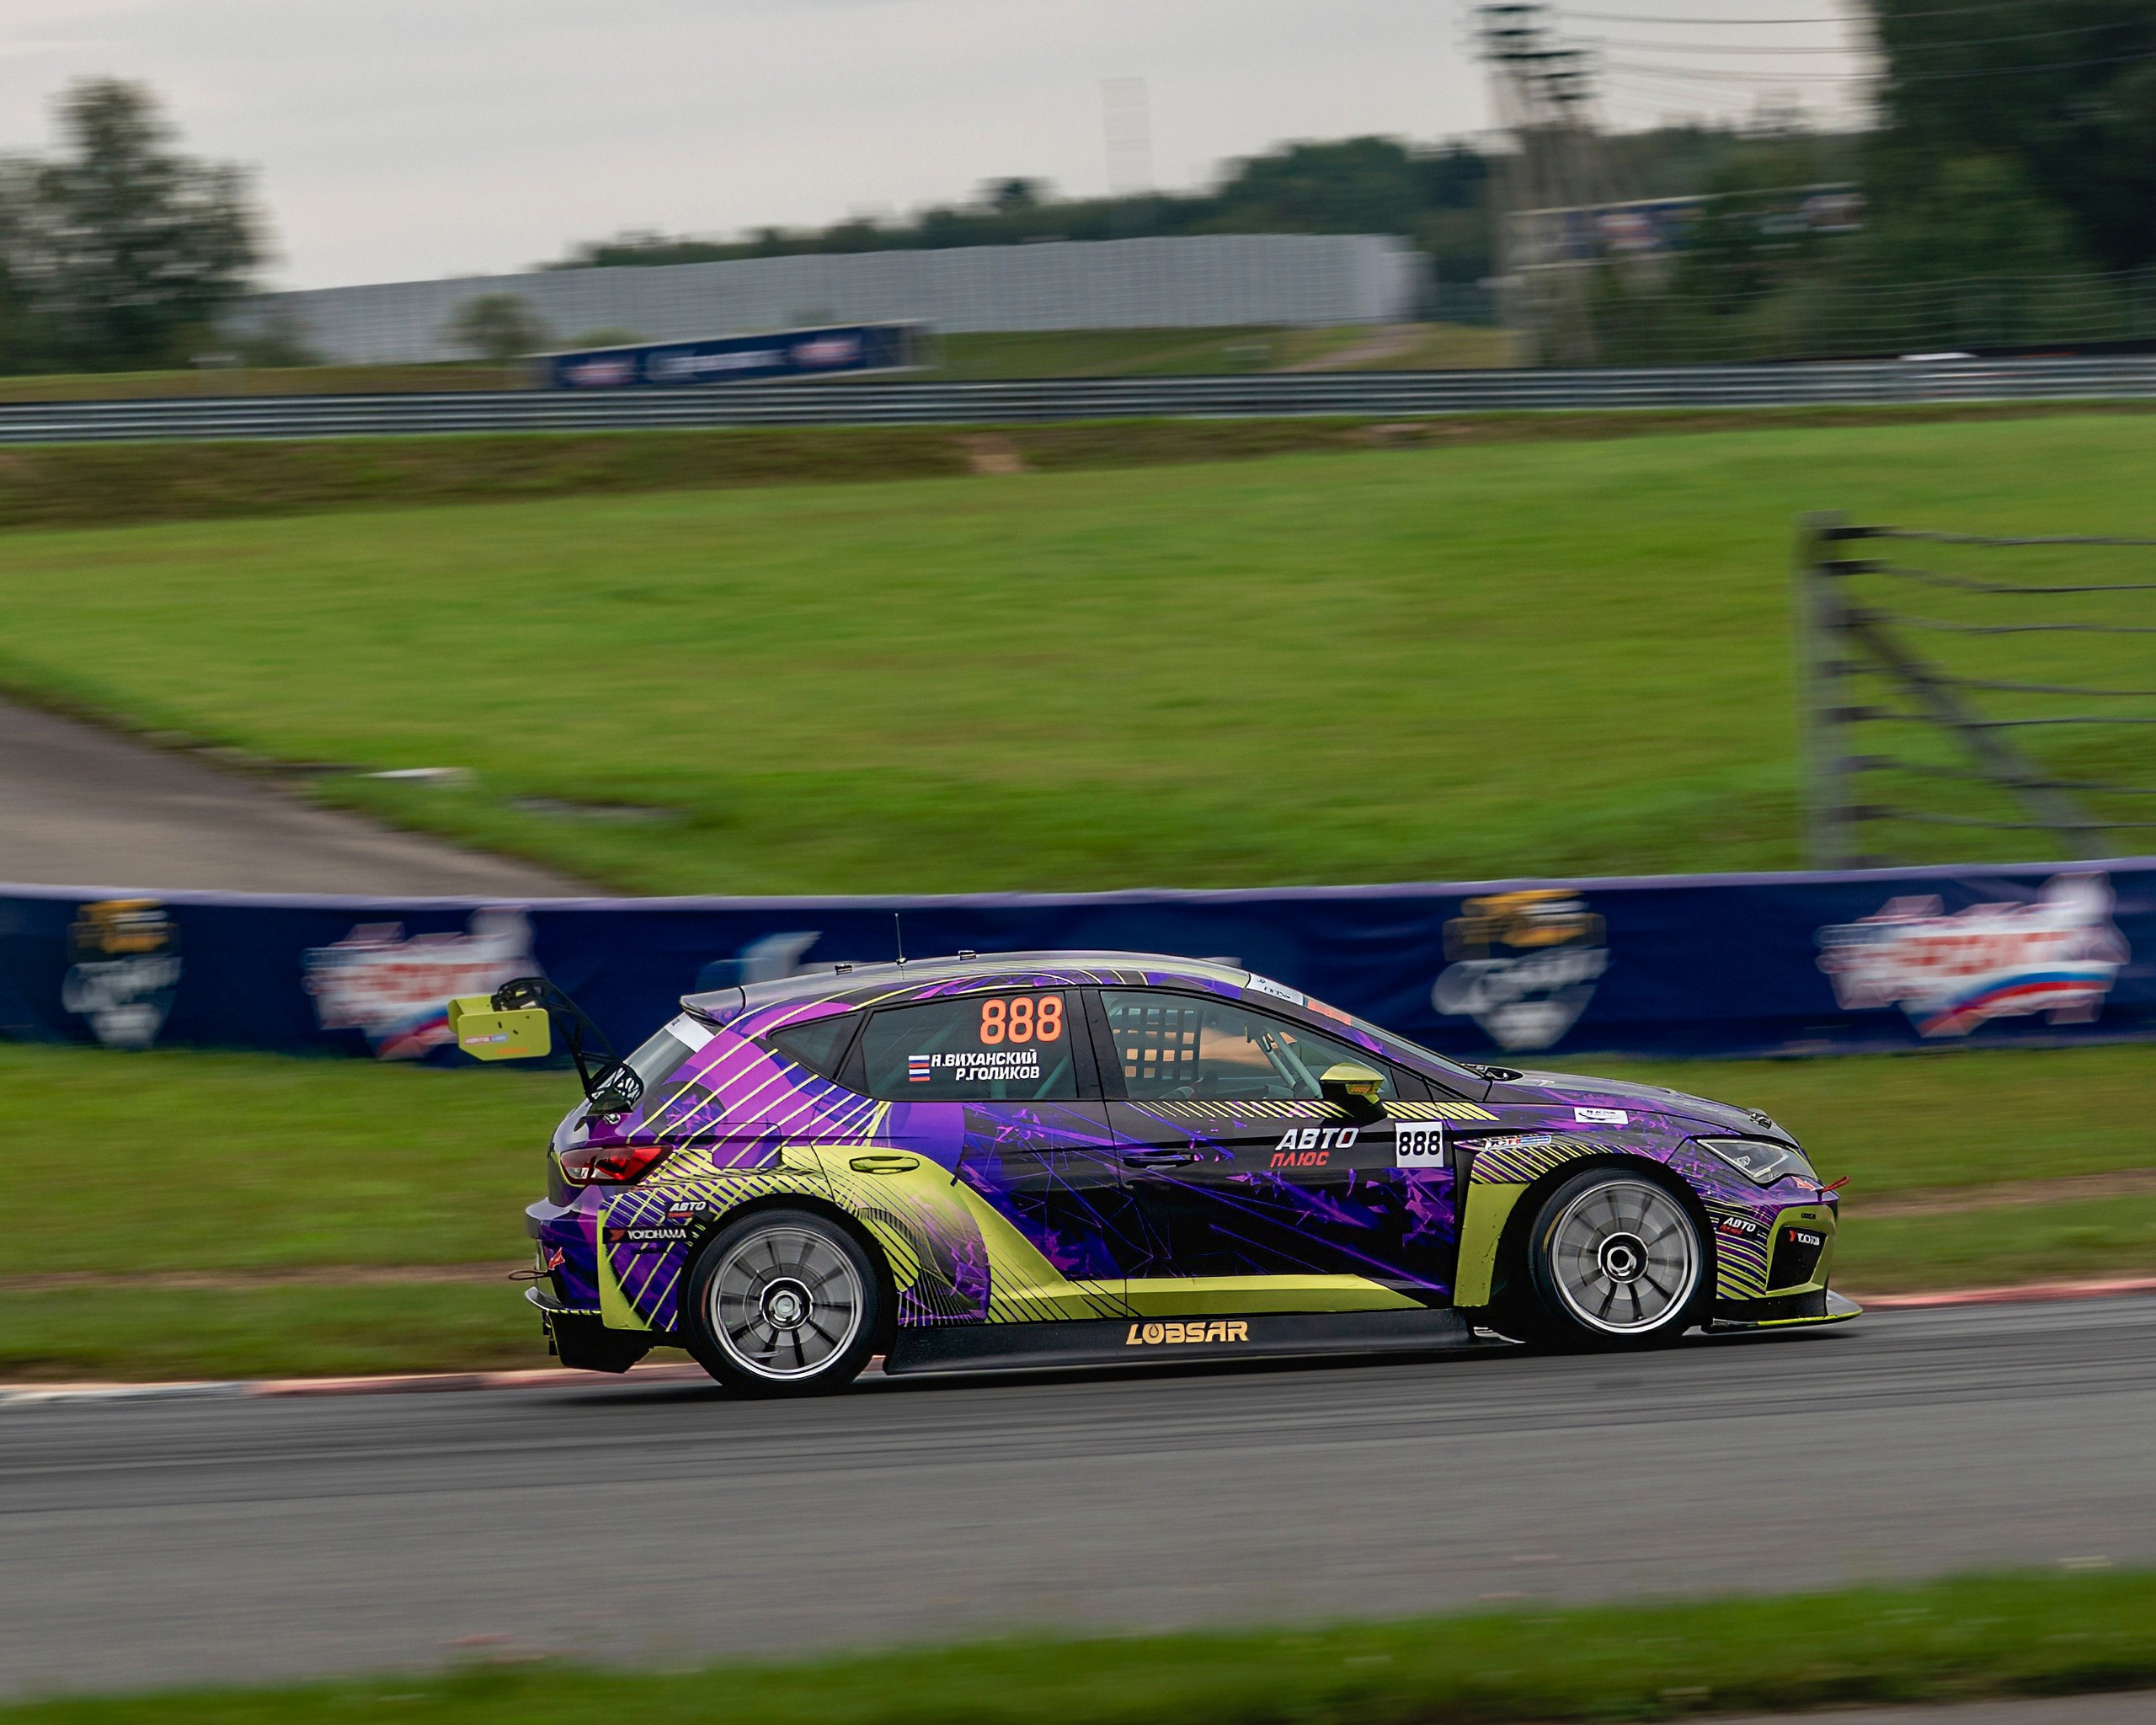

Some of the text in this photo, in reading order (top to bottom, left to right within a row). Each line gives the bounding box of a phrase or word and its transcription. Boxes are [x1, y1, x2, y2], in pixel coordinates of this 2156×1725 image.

[979, 996, 1063, 1045] 888
[955, 1065, 1040, 1081] Р.ГОЛИКОВ
[1274, 1127, 1359, 1151] АВТО
[1399, 1130, 1441, 1156] 888
[1269, 1151, 1330, 1168] ПЛЮС
[1125, 1321, 1250, 1345] LOBSAR
